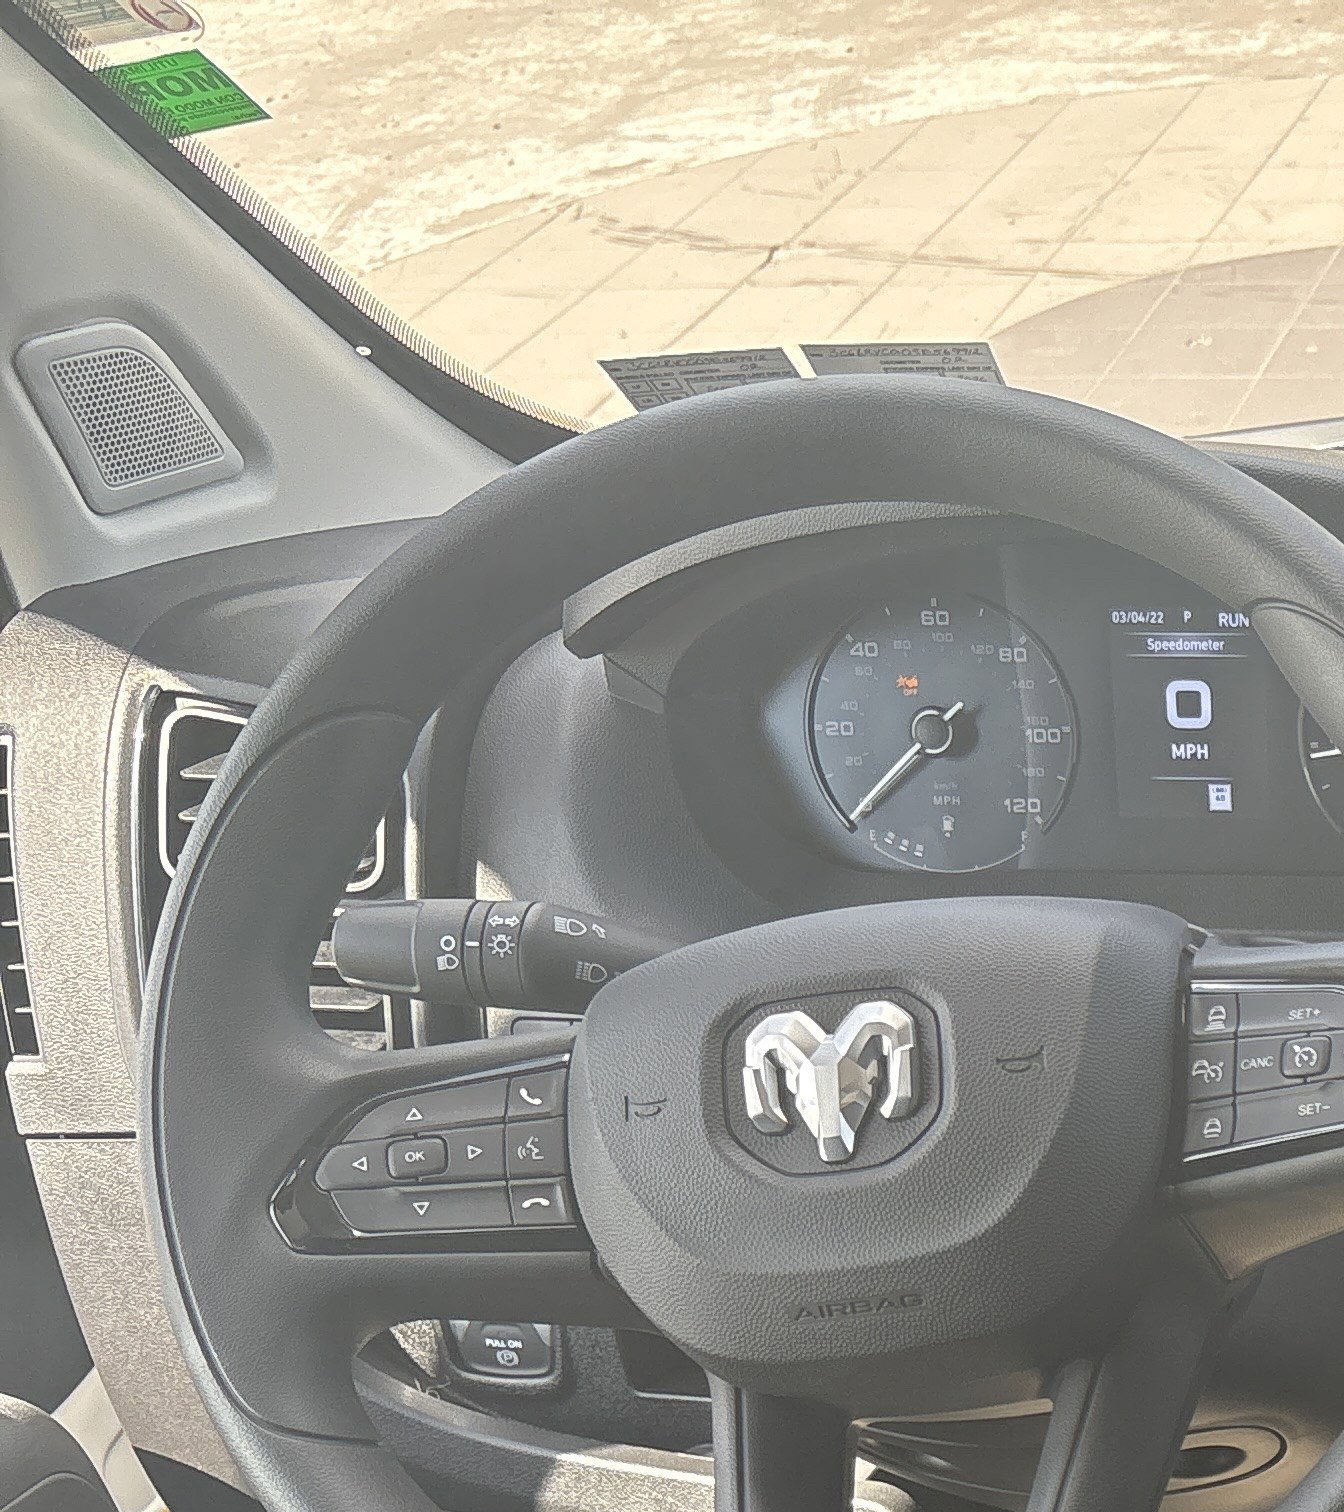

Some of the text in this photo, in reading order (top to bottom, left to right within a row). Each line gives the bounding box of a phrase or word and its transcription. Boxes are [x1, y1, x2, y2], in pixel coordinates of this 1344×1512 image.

[920, 610, 950, 626] 60
[1111, 611, 1164, 624] 03/04/22
[1183, 611, 1192, 623] P
[1218, 612, 1250, 628] RUN
[849, 641, 879, 658] 40
[1147, 638, 1225, 653] Speedometer
[999, 647, 1028, 663] 80
[1165, 679, 1212, 729] 0
[825, 721, 854, 737] 20
[1025, 728, 1061, 744] 100
[1171, 743, 1209, 760] MPH
[933, 795, 961, 807] MPH
[1004, 798, 1041, 814] 120
[1240, 1056, 1274, 1071] CANC
[405, 1149, 426, 1163] OK
[793, 1296, 933, 1323] AIRBAG
[485, 1338, 523, 1349] PULL ON
